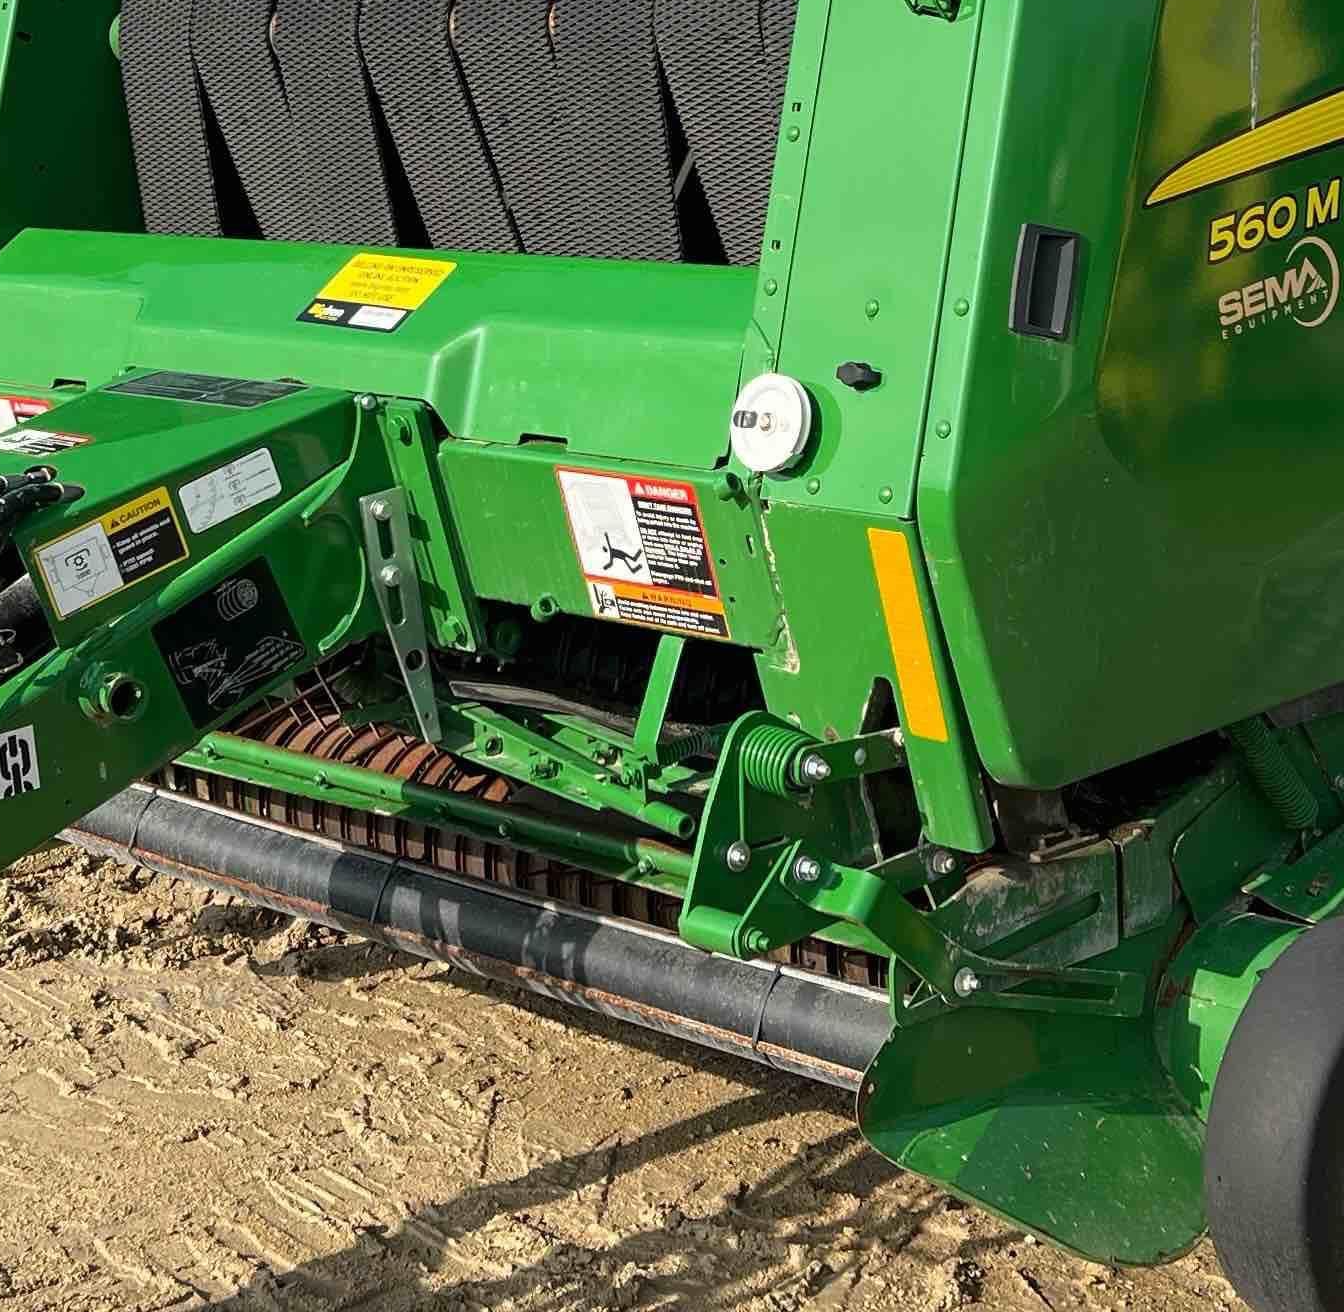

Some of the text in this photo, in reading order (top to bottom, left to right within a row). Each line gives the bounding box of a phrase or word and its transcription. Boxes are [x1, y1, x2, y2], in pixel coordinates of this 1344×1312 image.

[1209, 178, 1341, 262] 560 M
[1218, 257, 1328, 326] SEMA
[1222, 290, 1329, 339] EQUIPMENT
[119, 497, 161, 523] CAUTION
